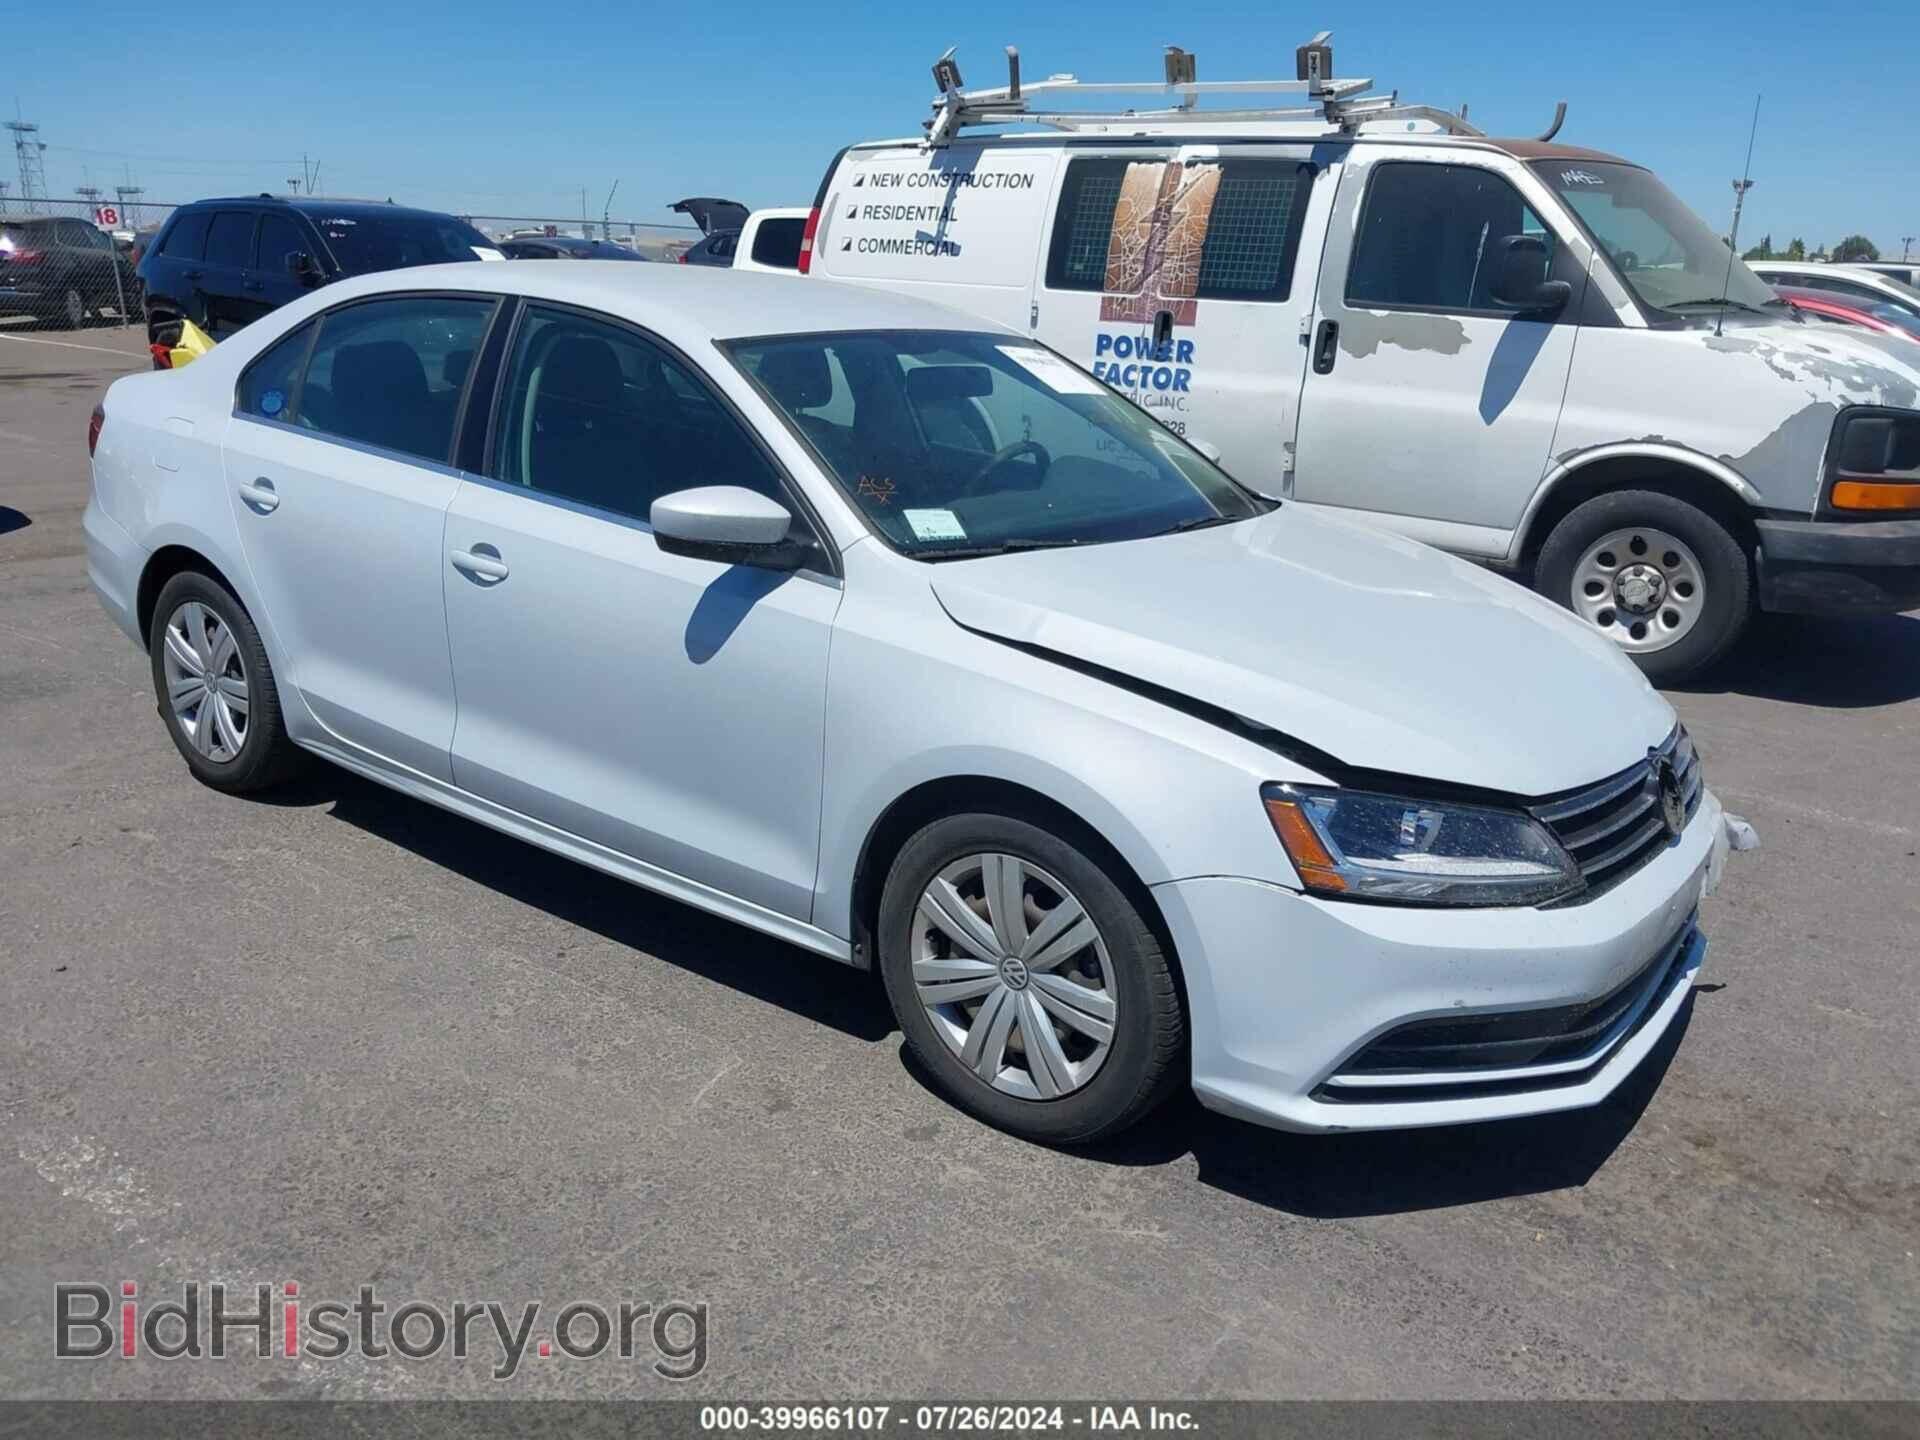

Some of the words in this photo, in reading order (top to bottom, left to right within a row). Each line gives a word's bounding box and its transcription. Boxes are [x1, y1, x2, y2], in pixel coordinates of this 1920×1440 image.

[869, 172, 903, 188] NEW
[907, 173, 1034, 189] CONSTRUCTION
[96, 208, 118, 225] 18
[862, 204, 958, 222] RESIDENTIAL
[857, 238, 959, 257] COMMERCIAL
[1095, 334, 1194, 364] POWER
[1093, 361, 1191, 392] FACTOR
[1159, 395, 1190, 413] INC.
